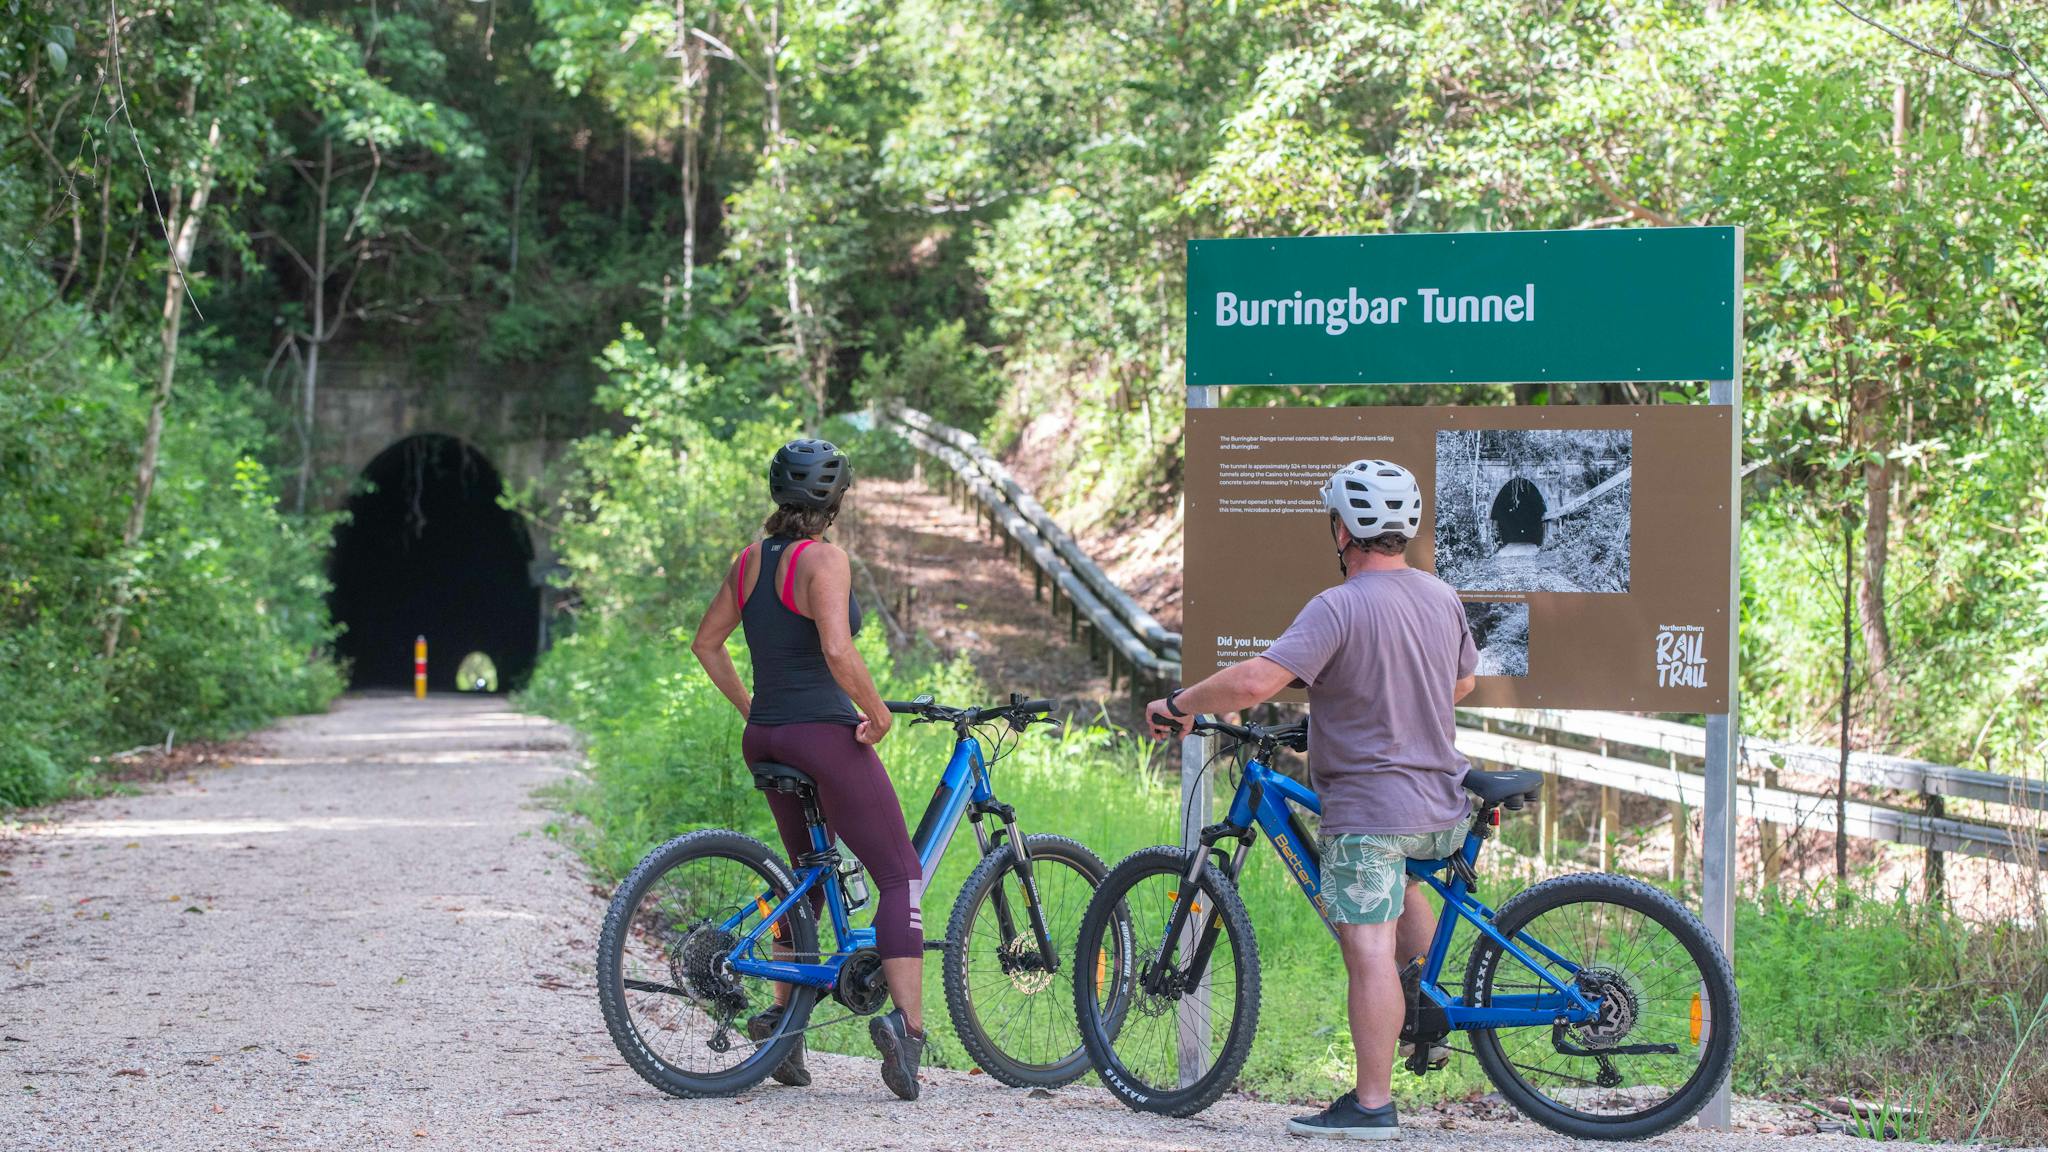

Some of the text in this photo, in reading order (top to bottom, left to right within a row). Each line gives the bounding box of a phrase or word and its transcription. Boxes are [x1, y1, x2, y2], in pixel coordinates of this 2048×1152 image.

[1216, 283, 1535, 335] Burringbar Tunnel
[1217, 636, 1232, 646] Did
[1234, 639, 1250, 649] you
[1656, 632, 1708, 665] RAIL
[1656, 660, 1708, 688] TRAIL
[1274, 833, 1316, 890] Better
[626, 1020, 664, 1071] MAXXIS
[1105, 1069, 1148, 1103] MAXXIS
